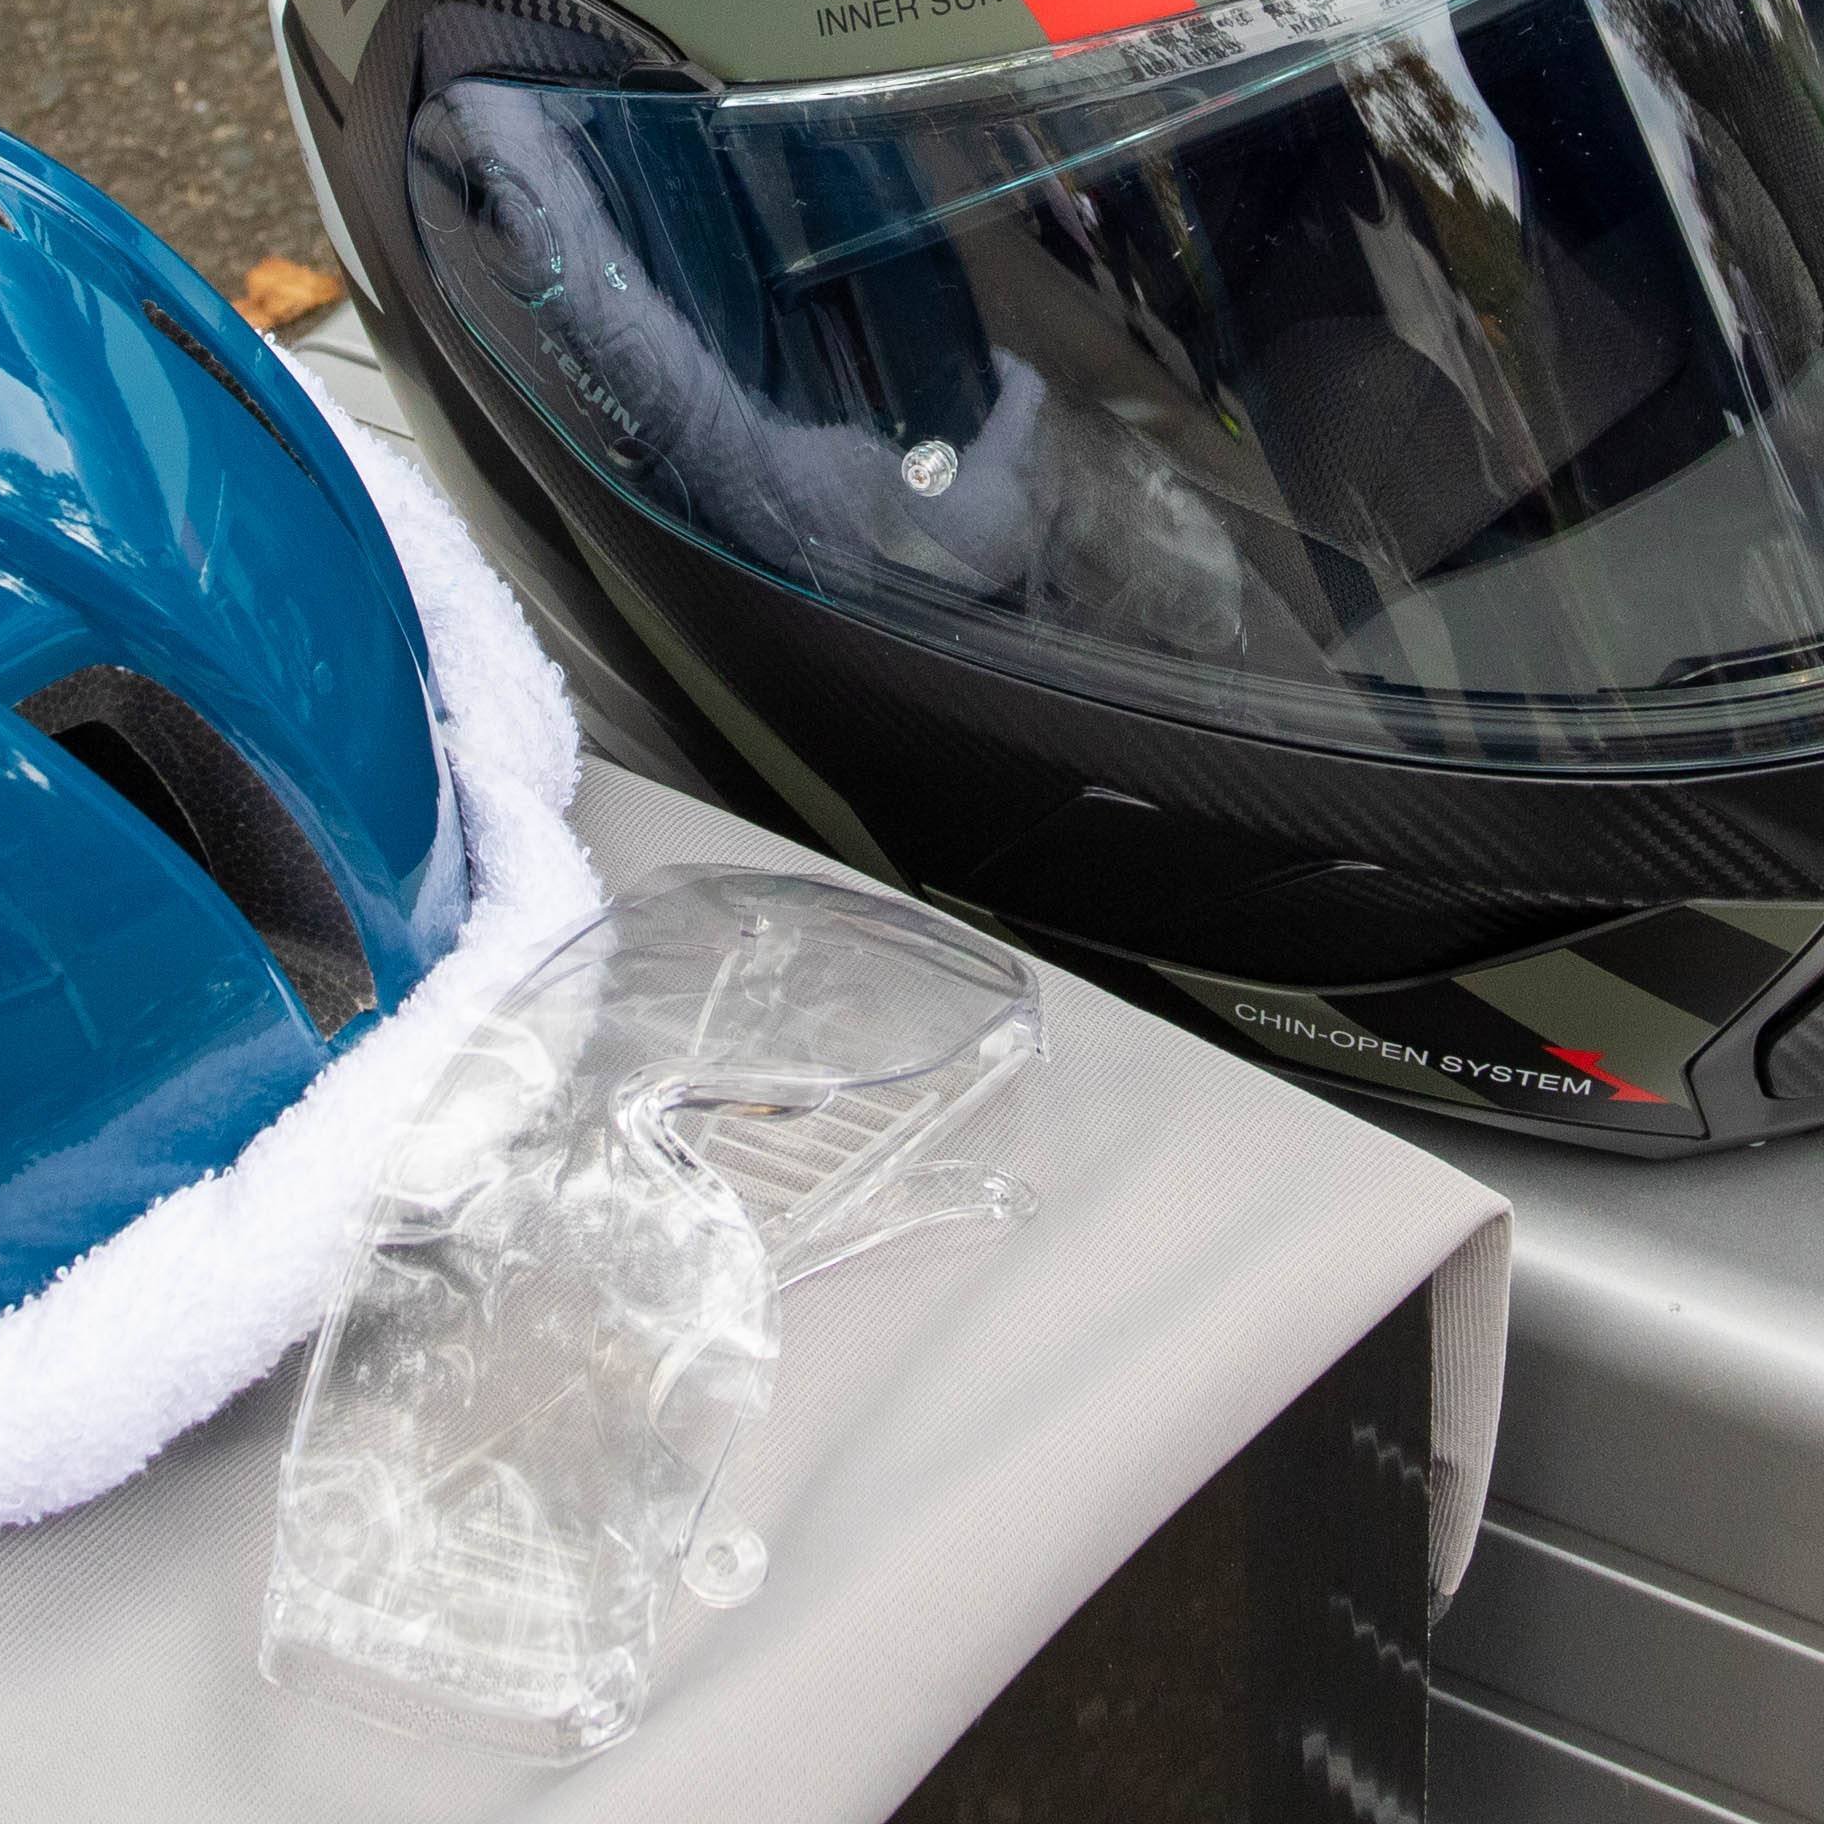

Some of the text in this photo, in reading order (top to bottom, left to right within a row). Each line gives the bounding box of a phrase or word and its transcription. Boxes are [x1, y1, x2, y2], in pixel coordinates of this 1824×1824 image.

[537, 328, 640, 437] TEIJIN
[1234, 1002, 1591, 1096] CHIN-OPEN SYSTEM
